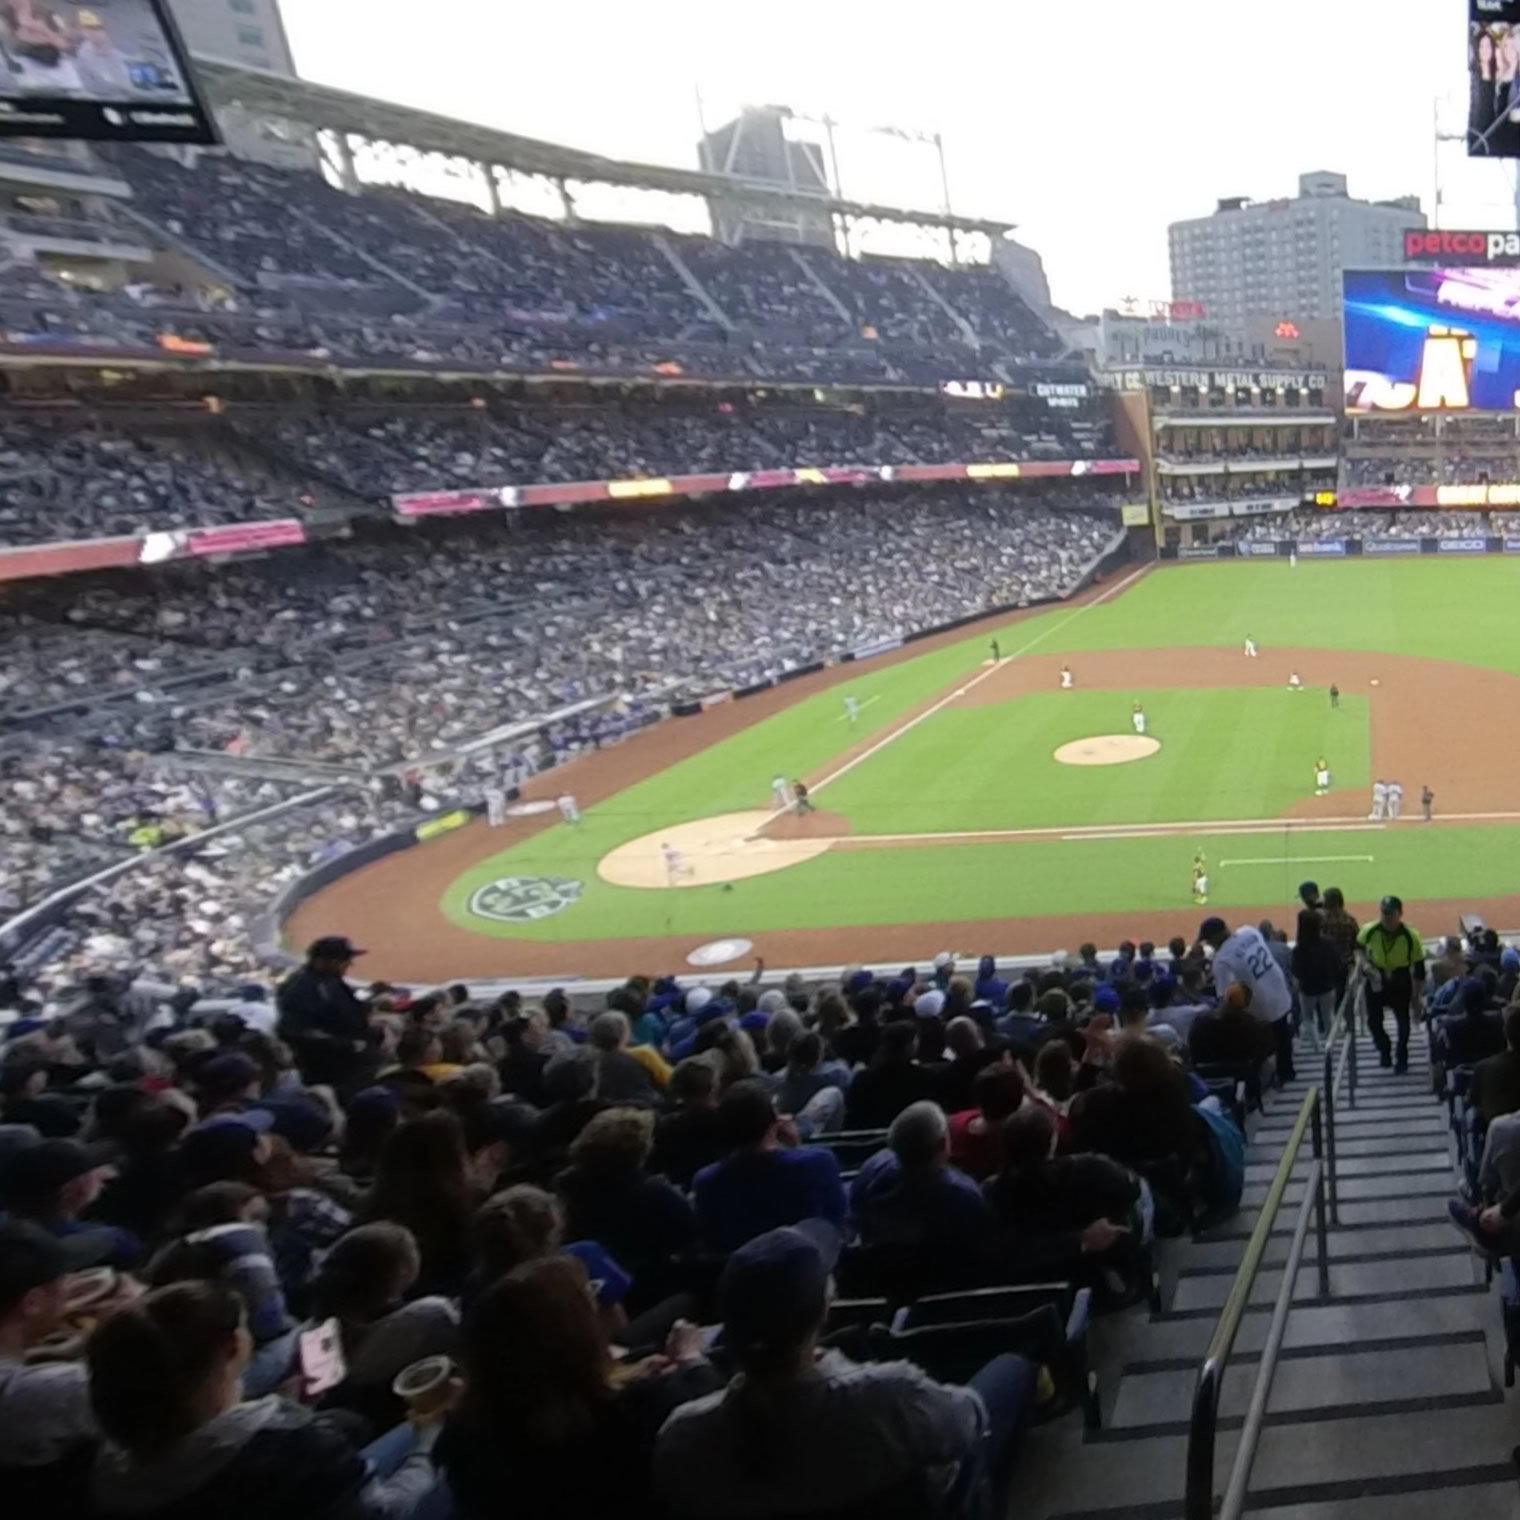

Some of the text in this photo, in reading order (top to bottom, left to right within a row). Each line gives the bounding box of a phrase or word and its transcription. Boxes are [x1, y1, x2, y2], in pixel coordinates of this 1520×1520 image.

[1146, 371, 1209, 388] WESTERN
[1214, 372, 1254, 387] METAL
[1259, 373, 1304, 389] SUPPLY
[1439, 539, 1485, 550] GEICO
[1247, 946, 1274, 981] 22
